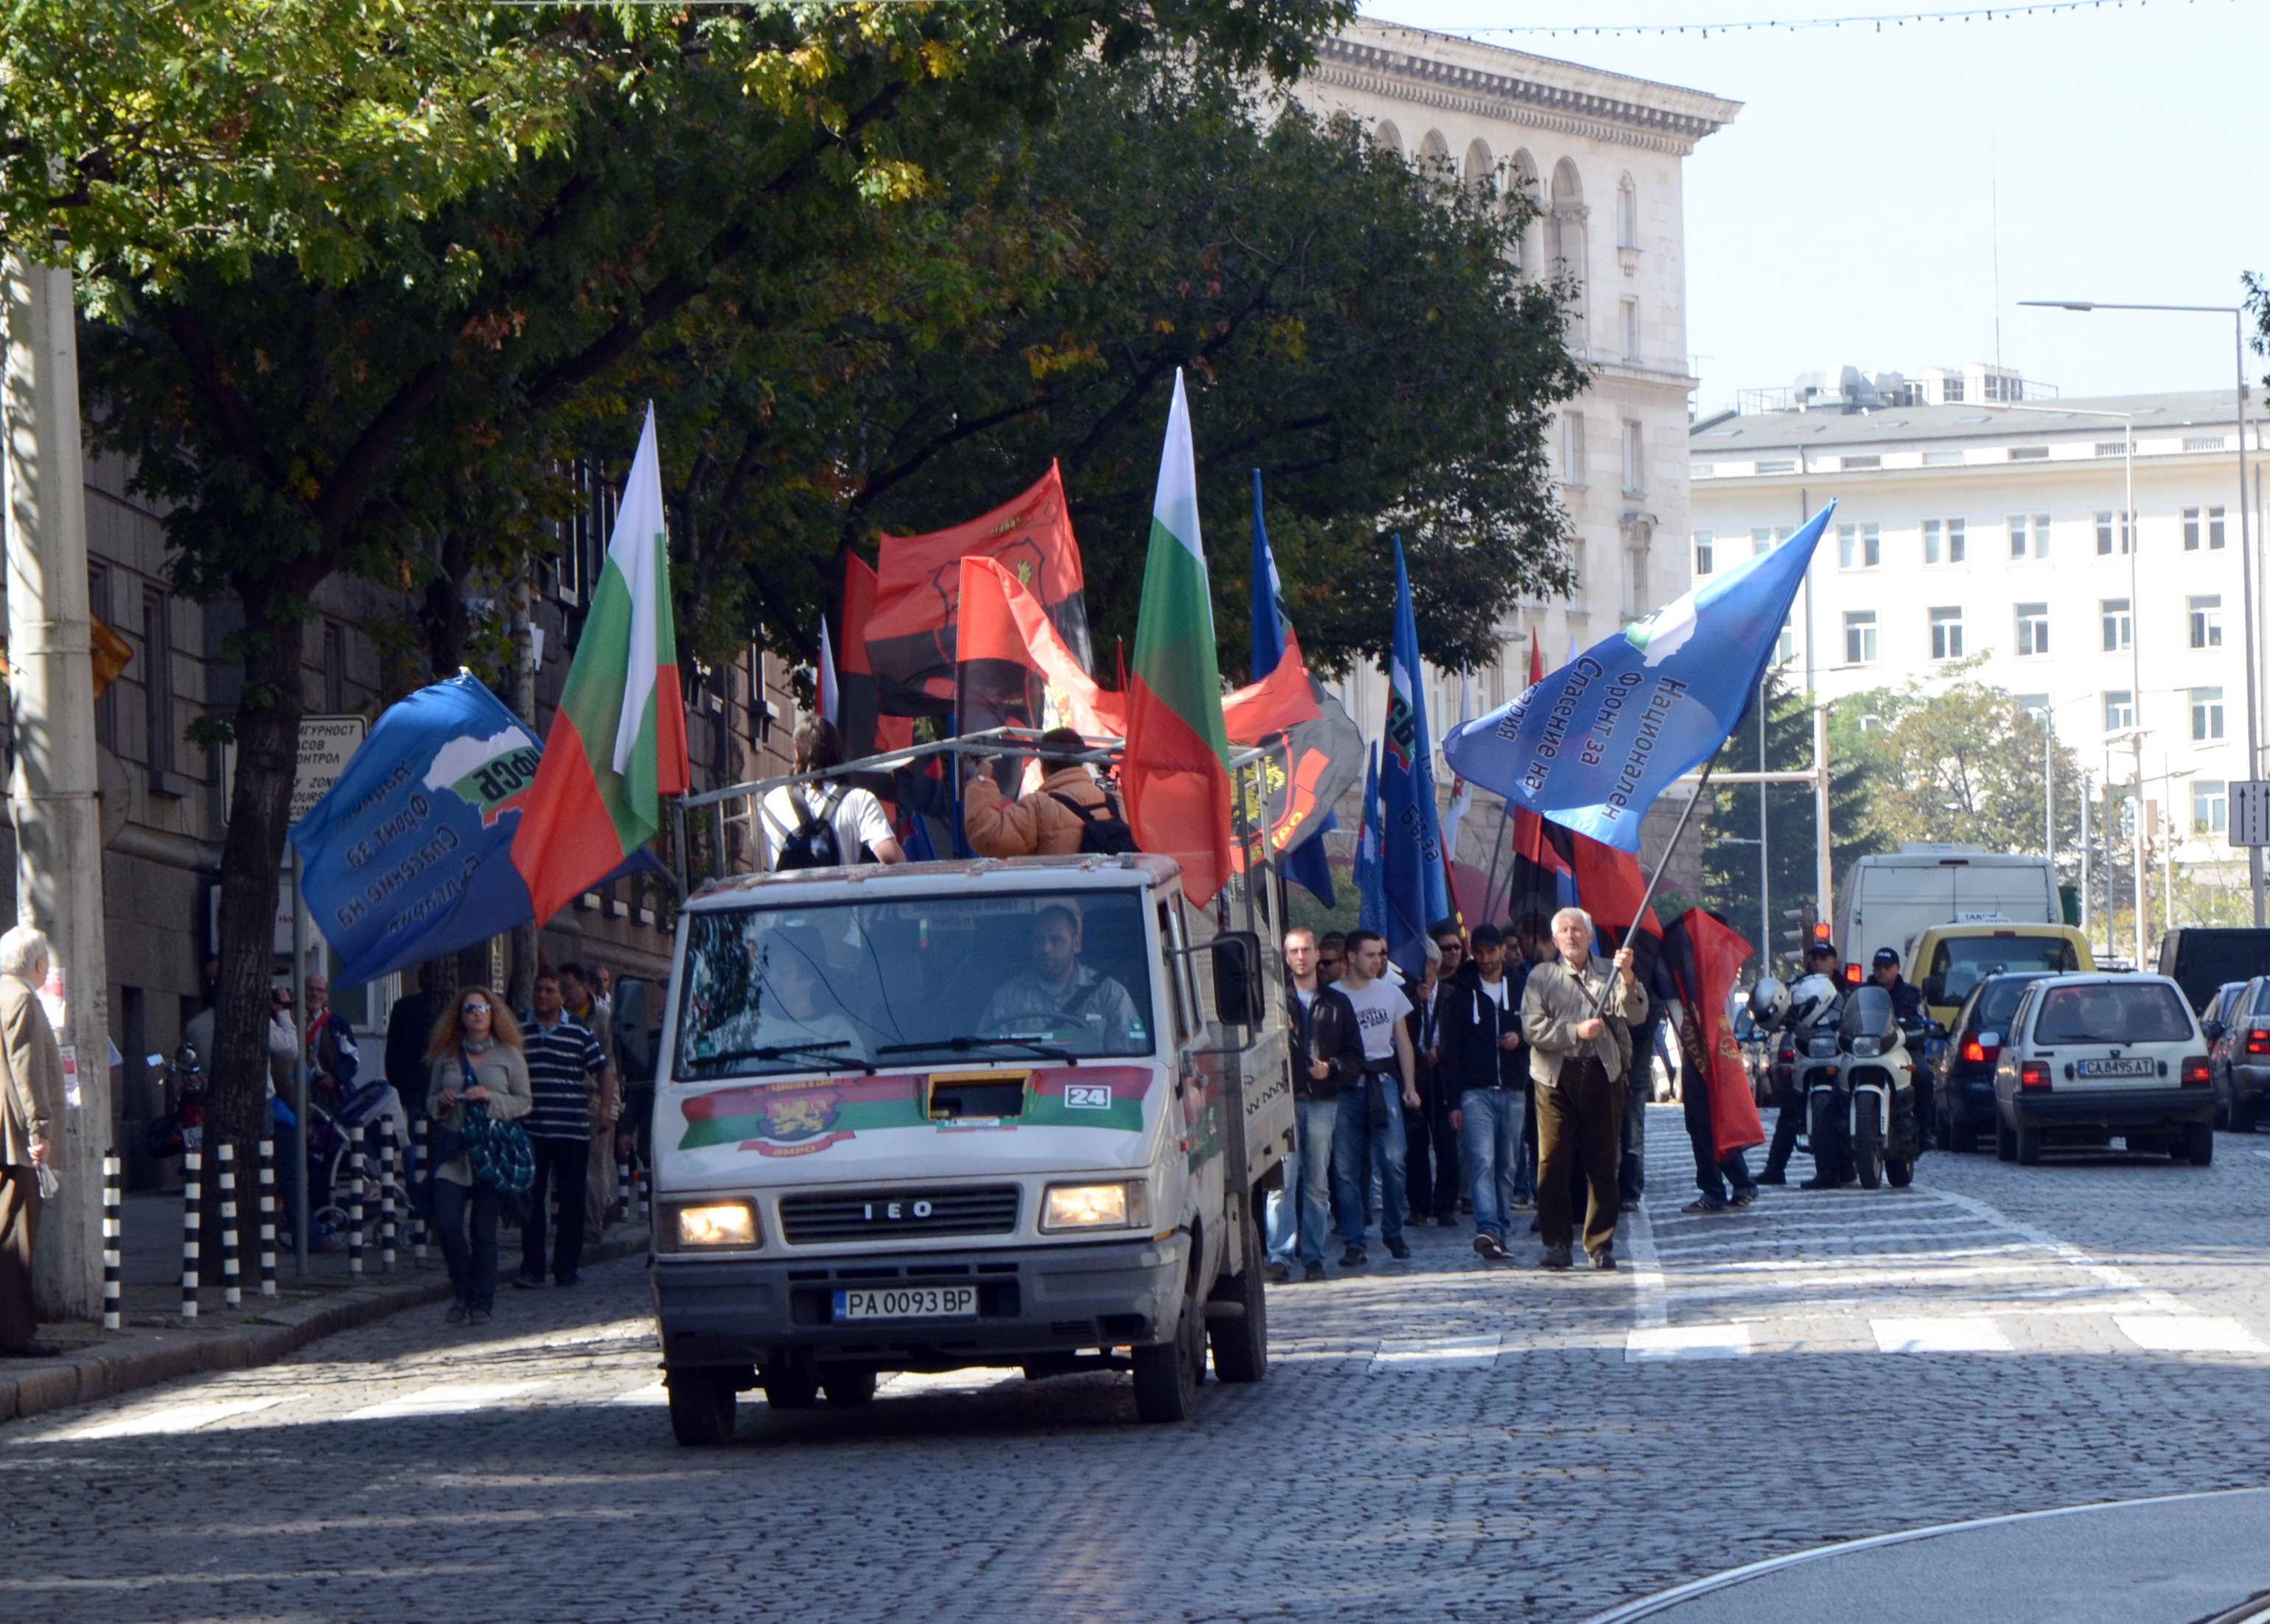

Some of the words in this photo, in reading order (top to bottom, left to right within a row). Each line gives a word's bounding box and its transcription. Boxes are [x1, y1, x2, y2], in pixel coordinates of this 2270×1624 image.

[1497, 682, 1540, 741] гария
[1536, 657, 1604, 758] Спасение
[1593, 671, 1644, 737] Фронт
[298, 725, 355, 736] ИГУРНОСТ
[301, 740, 325, 750] СОВ
[1579, 739, 1604, 766] за
[1601, 676, 1688, 821] Национален
[297, 753, 340, 764] ОНТРОЛ
[1523, 760, 1548, 791] на
[294, 791, 324, 802] OURS
[1069, 1088, 1106, 1105] 24
[884, 1291, 938, 1314] 0093
